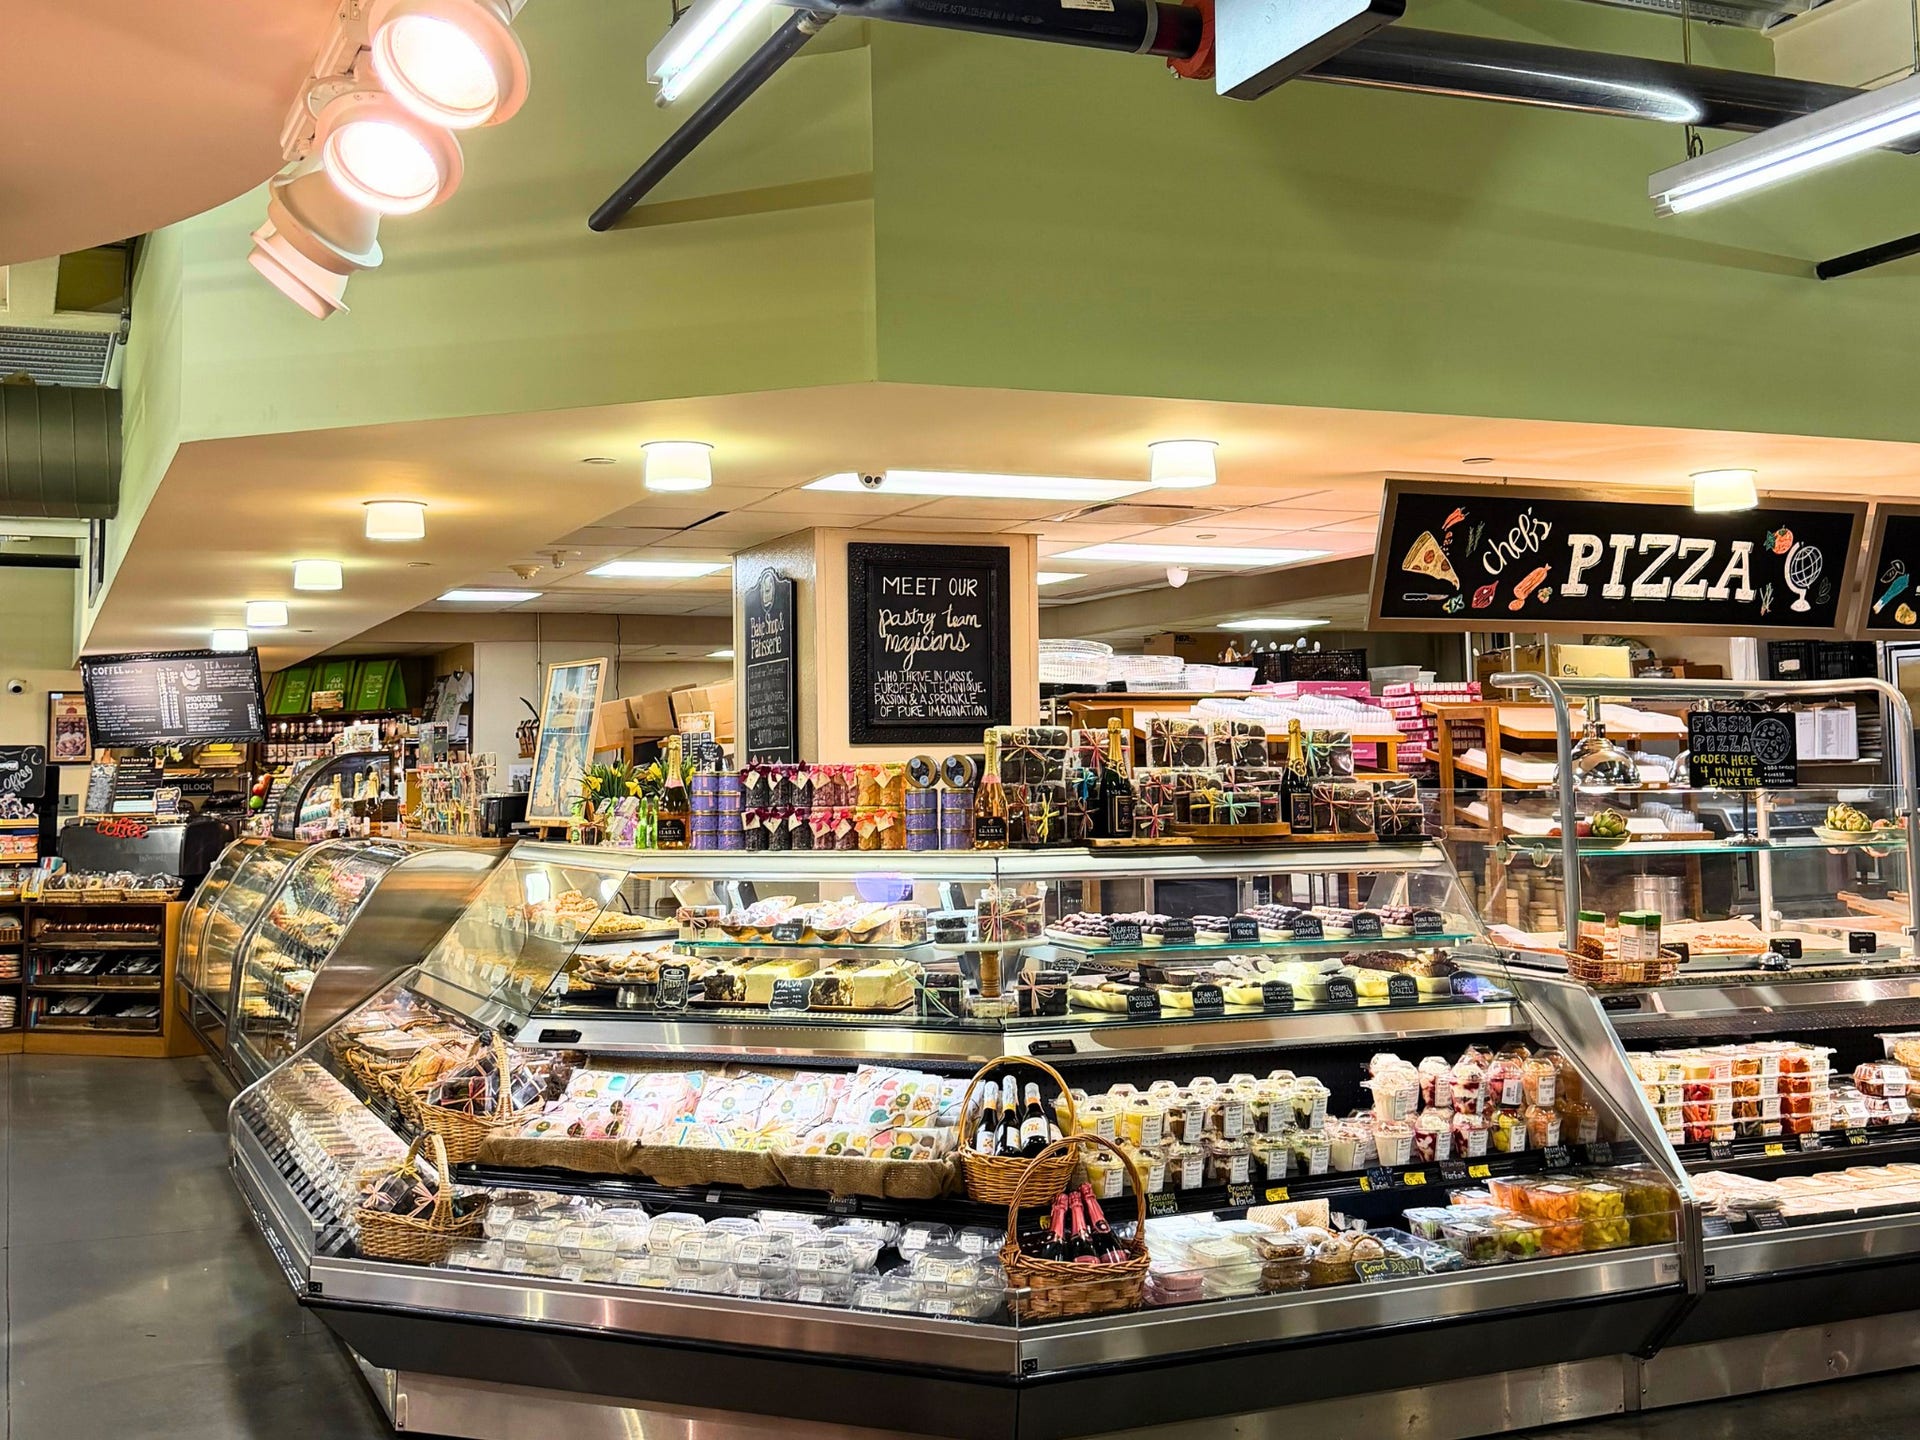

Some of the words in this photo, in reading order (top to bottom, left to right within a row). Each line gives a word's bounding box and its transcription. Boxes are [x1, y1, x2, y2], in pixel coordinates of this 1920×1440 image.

[1482, 506, 1553, 576] chef's
[1560, 533, 1756, 603] PIZZA
[882, 576, 942, 597] MEET
[948, 577, 978, 597] OUR
[878, 606, 937, 639] pastry
[941, 603, 982, 628] team
[884, 630, 971, 671] magicians
[92, 666, 124, 676] COFFEE
[204, 661, 221, 670] TEA
[877, 670, 897, 682] WHO
[900, 670, 931, 682] THRIVE
[933, 670, 943, 682] IN
[874, 682, 927, 694] EUROPEAN
[874, 693, 908, 705] PASSION
[909, 693, 919, 705] &
[920, 694, 928, 705] A
[929, 693, 978, 705] SPRINKLE
[880, 706, 893, 717] OF
[897, 705, 925, 717] PURE
[928, 705, 988, 717] IMAGINATION
[1692, 715, 1752, 733] FRESH
[1693, 735, 1751, 752] PIZZA
[1692, 754, 1729, 765] ORDER
[1731, 754, 1758, 766] HERE
[1700, 766, 1709, 778] 4
[1715, 767, 1753, 777] MINUTE
[182, 782, 212, 791] BLOCK
[1709, 777, 1741, 787] BAKE
[1743, 777, 1763, 786] TIME
[1361, 1261, 1388, 1274] Good
